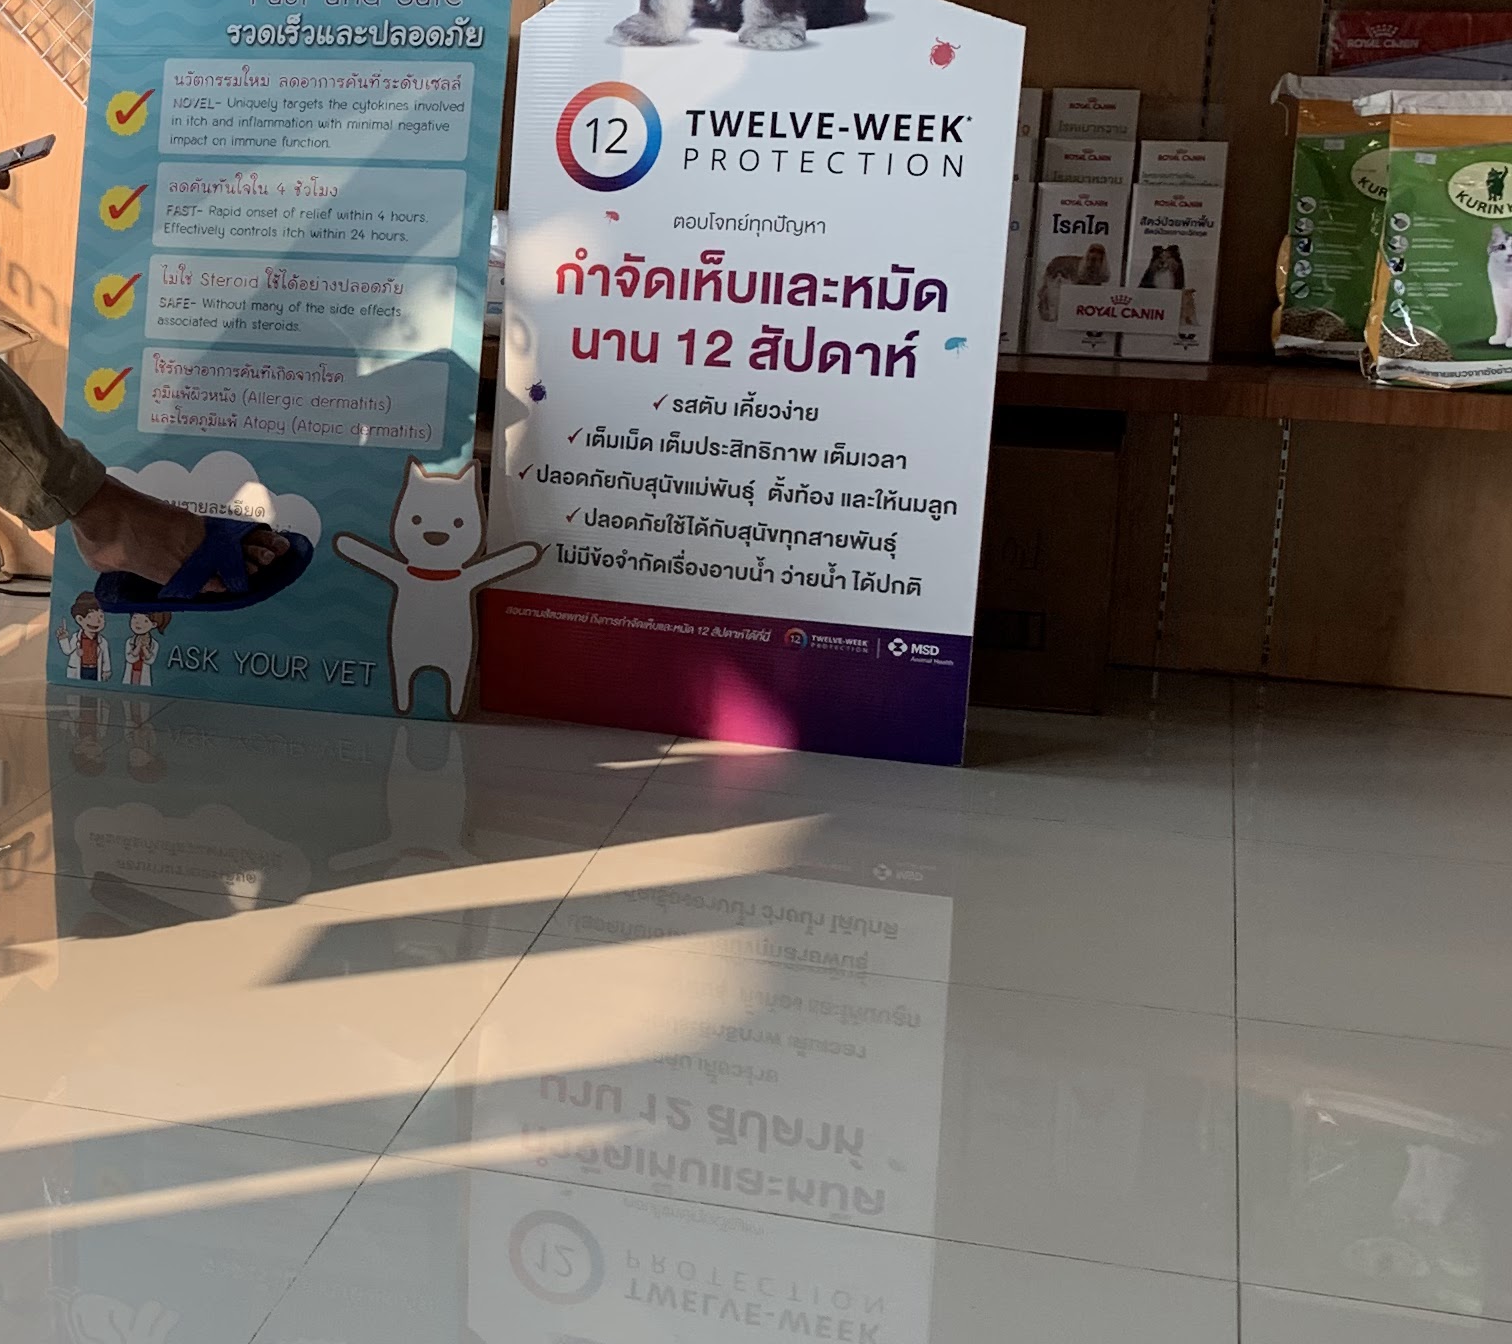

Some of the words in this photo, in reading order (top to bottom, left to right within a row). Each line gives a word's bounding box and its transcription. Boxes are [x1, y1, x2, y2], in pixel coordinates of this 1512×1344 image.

[226, 12, 485, 49] รวดเร็วและปลอดภัย
[227, 98, 278, 112] Uniquely
[283, 99, 323, 112] targets
[329, 99, 347, 110] the
[352, 101, 409, 114] cytokines
[414, 100, 465, 112] involved
[171, 116, 182, 126] in
[187, 116, 207, 126] itch
[212, 117, 233, 127] and
[238, 116, 313, 128] inflammation
[318, 118, 342, 129] with
[346, 119, 393, 131] minimal
[398, 121, 449, 134] negative
[170, 134, 208, 147] impact
[212, 138, 226, 146] on
[232, 136, 277, 147] immune
[585, 116, 628, 155] 12
[683, 147, 965, 178] PROTECTION
[276, 182, 286, 195] 4
[209, 206, 242, 219] Rapid
[246, 208, 278, 219] onset
[283, 208, 296, 219] of
[300, 208, 332, 220] relief
[337, 209, 373, 221] within
[378, 211, 384, 221] 4
[164, 223, 225, 238] Effectively
[230, 226, 278, 238] controls
[283, 226, 305, 238] itch
[310, 228, 346, 240] within
[350, 229, 366, 240] 24
[673, 212, 827, 238] ตอบโจทย์ทุกปัญหา
[1052, 213, 1109, 236] โรคไต
[200, 273, 259, 288] Steroid
[555, 247, 949, 314] กำจัดเห็บและหมัด
[202, 298, 246, 311] Without
[251, 301, 283, 315] many
[288, 301, 301, 312] of
[306, 302, 325, 314] the
[330, 303, 354, 315] side
[360, 304, 402, 317] effects
[1076, 305, 1118, 318] ROYAL
[1121, 307, 1164, 321] CANIN
[157, 315, 218, 328] associated
[223, 317, 247, 329] with
[571, 326, 660, 365] นาน
[677, 328, 733, 368] 12
[748, 323, 921, 379] สัปดาห์
[242, 388, 304, 409] (Allergic
[311, 394, 391, 413] dermatitis)
[672, 396, 727, 417] รสตับ
[734, 391, 819, 422] เคี้ยวง่าย
[243, 416, 285, 434] Atopy
[292, 416, 344, 436] (Atopic
[586, 425, 653, 452] เต็มเม็ด
[660, 435, 816, 464] เต็มประสิทธิภาพ
[823, 443, 907, 470] เต็มเวลา
[767, 475, 835, 507] ตั้งท้อง
[840, 488, 958, 521] และให้นมลูก
[780, 561, 847, 591] ว่ายน้ำ
[852, 572, 923, 598] ได้ปกติ
[697, 626, 709, 636] 12
[811, 635, 869, 647] TWELVE-WEEK
[911, 643, 939, 656] MSD
[167, 644, 220, 673] ASK
[233, 651, 309, 681] YOUR
[320, 660, 377, 687] VET
